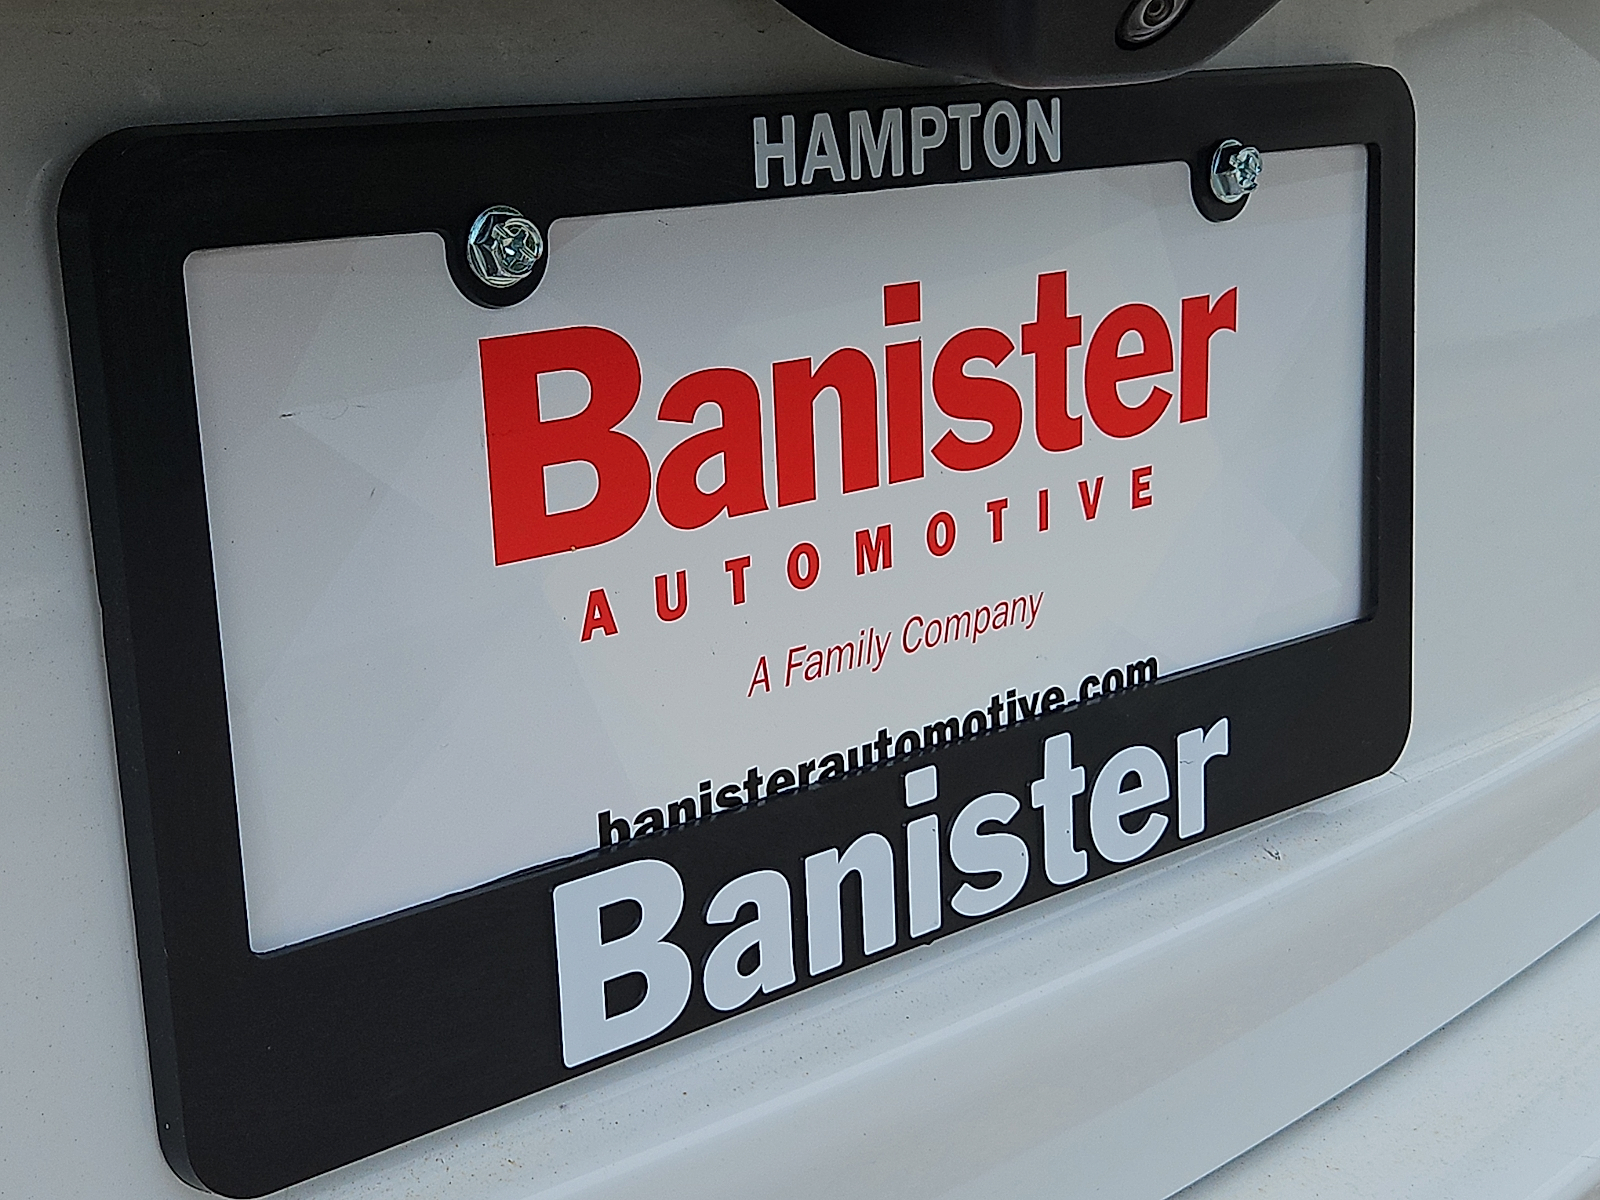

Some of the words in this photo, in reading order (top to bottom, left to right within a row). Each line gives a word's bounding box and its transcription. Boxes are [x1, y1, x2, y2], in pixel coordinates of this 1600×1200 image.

[753, 97, 1062, 190] HAMPTON
[479, 270, 1238, 566] Banister
[580, 465, 1154, 643] AUTOMOTIVE
[747, 655, 772, 698] A
[784, 627, 892, 688] Family
[901, 590, 1045, 655] Company
[597, 655, 1159, 849] banisterautomotive.com
[552, 717, 1230, 1068] Banister
